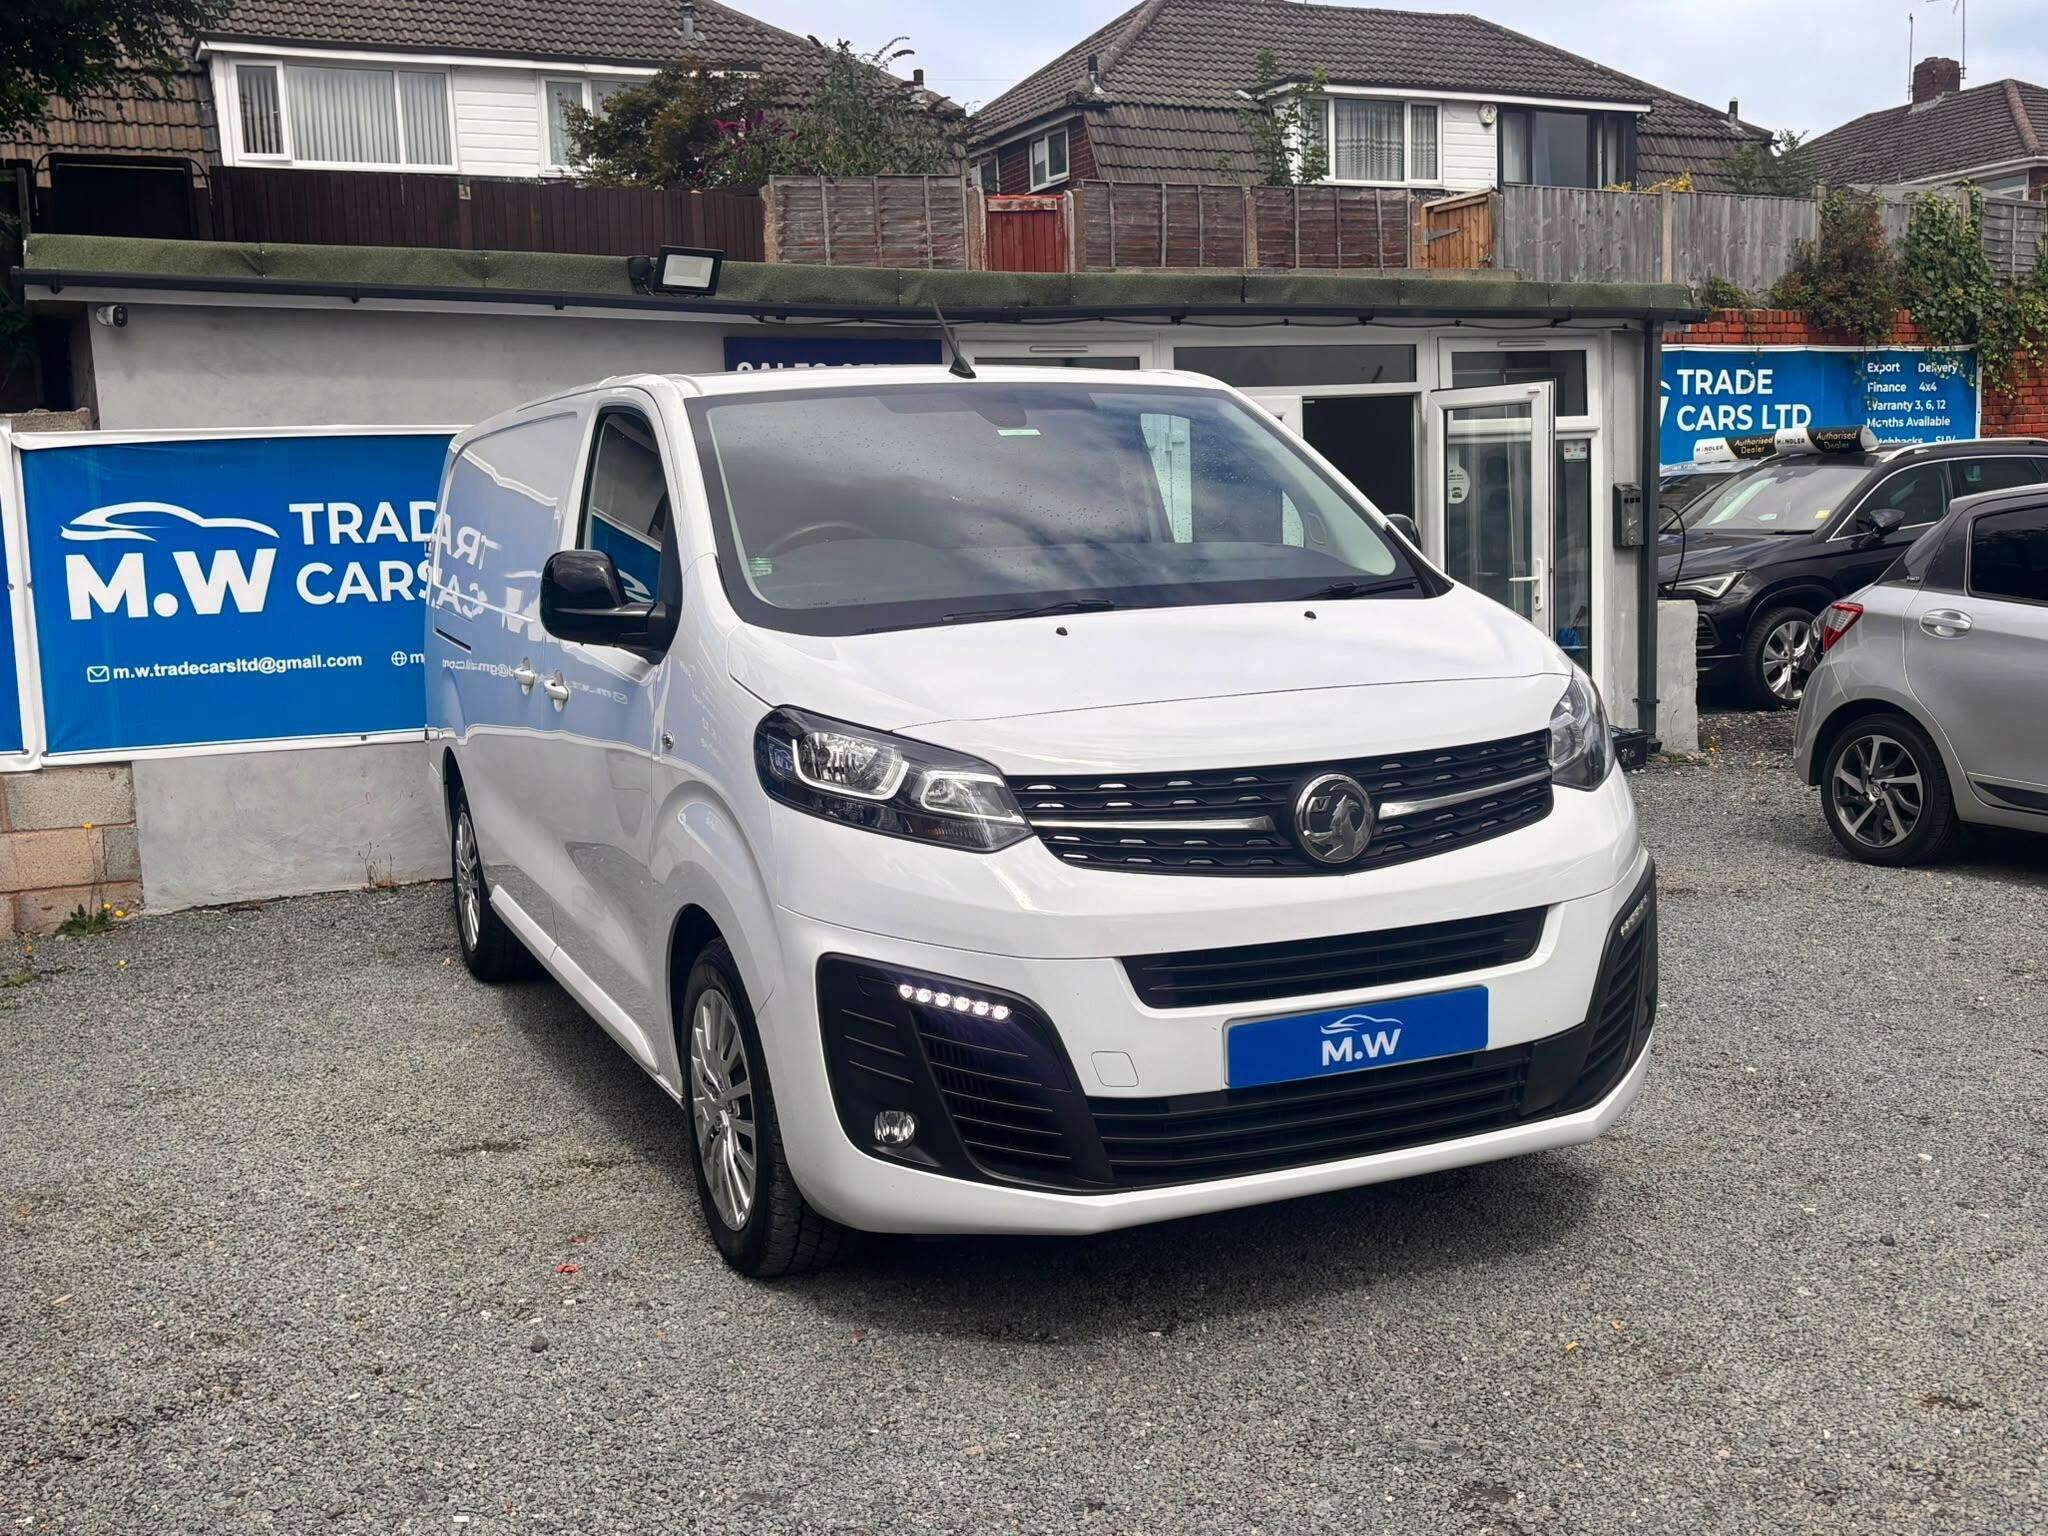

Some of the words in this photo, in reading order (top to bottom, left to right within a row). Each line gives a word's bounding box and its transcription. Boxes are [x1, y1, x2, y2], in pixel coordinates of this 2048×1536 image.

[1867, 362, 1901, 375] Export
[1918, 362, 1958, 375] Delivery
[1676, 369, 1774, 395] TRADE
[1867, 381, 1907, 393] Finance
[1919, 381, 1938, 392] 4x4
[1915, 400, 1924, 412] 3,
[1925, 400, 1935, 412] 6,
[1937, 400, 1946, 410] 12
[1676, 404, 1755, 432] CARS
[1761, 403, 1812, 430] LTD
[1867, 417, 1904, 428] Months
[1906, 416, 1951, 427] Available
[1734, 437, 1775, 447] Authorised
[1816, 432, 1857, 441] Authorised
[1740, 446, 1765, 454] Dealer
[289, 501, 437, 546] TRAD
[65, 548, 277, 620] M.W
[113, 653, 363, 680] m.w.tradecarsltd@gmail.com
[1321, 1028, 1402, 1066] M.W
